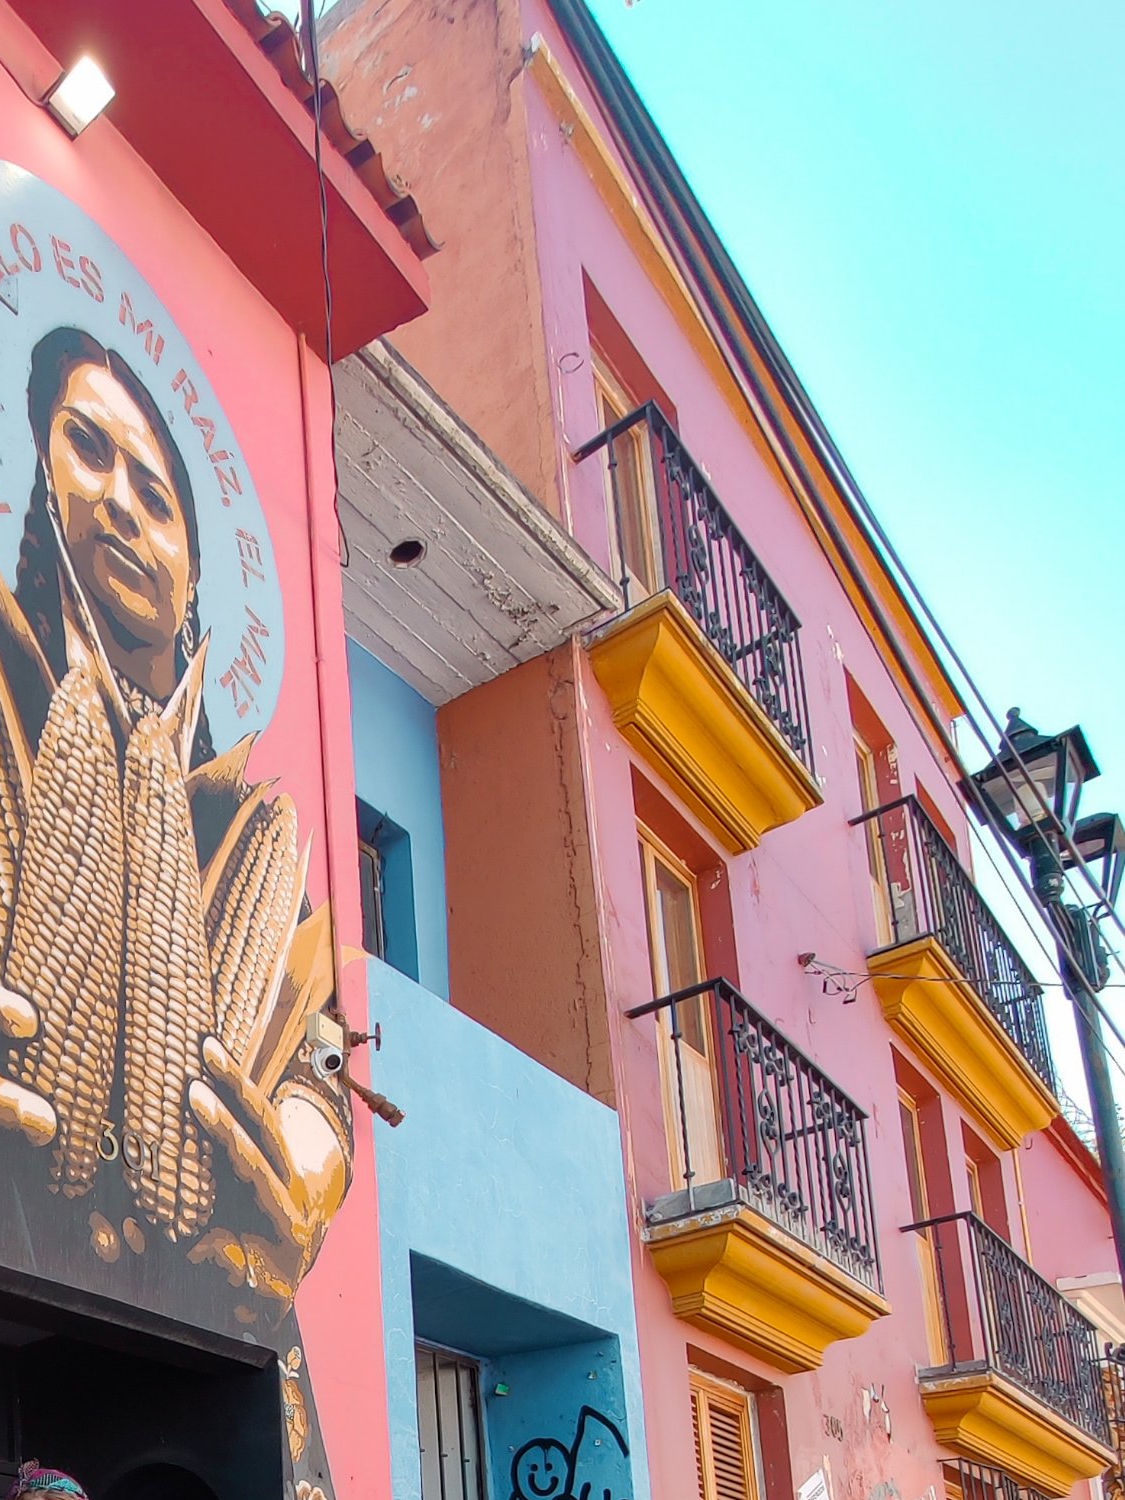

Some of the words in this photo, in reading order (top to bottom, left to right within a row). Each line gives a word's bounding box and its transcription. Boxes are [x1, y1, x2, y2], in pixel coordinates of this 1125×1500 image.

[51, 234, 105, 304] ES
[118, 291, 165, 367] MI
[235, 528, 266, 589] EL
